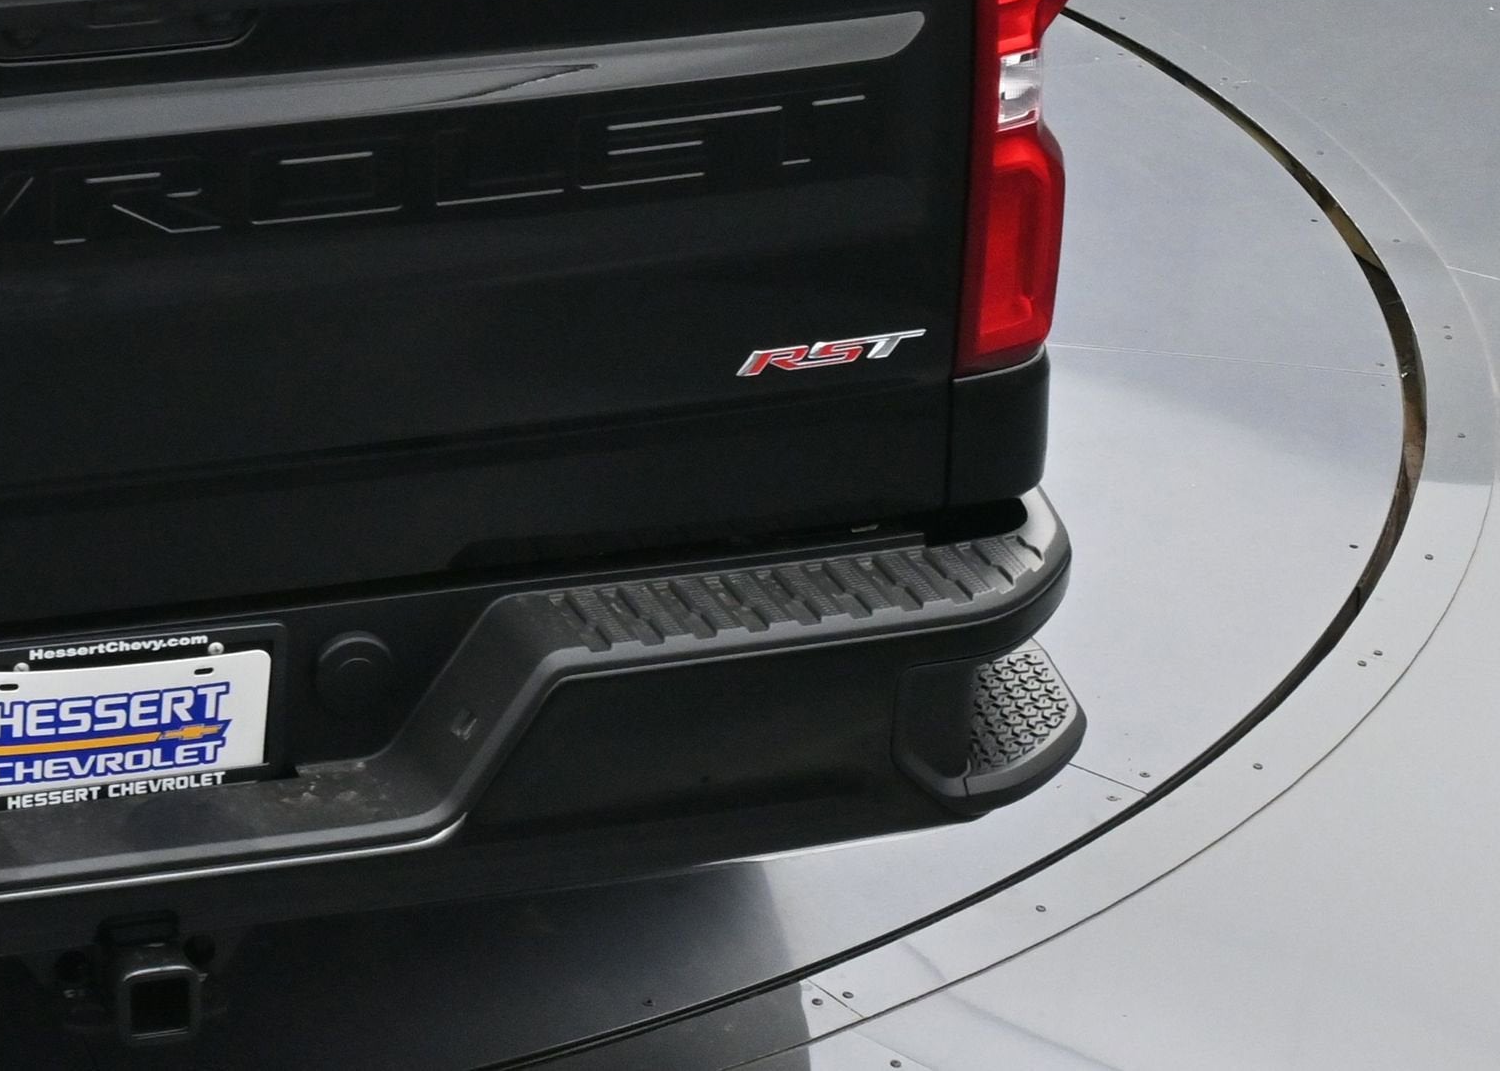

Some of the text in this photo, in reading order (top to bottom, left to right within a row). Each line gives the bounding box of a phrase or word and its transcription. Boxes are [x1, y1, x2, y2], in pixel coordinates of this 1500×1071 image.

[736, 328, 927, 377] RST
[28, 634, 209, 662] HessertChevy.com
[7, 770, 226, 810] HESSERT CHEVROLET
